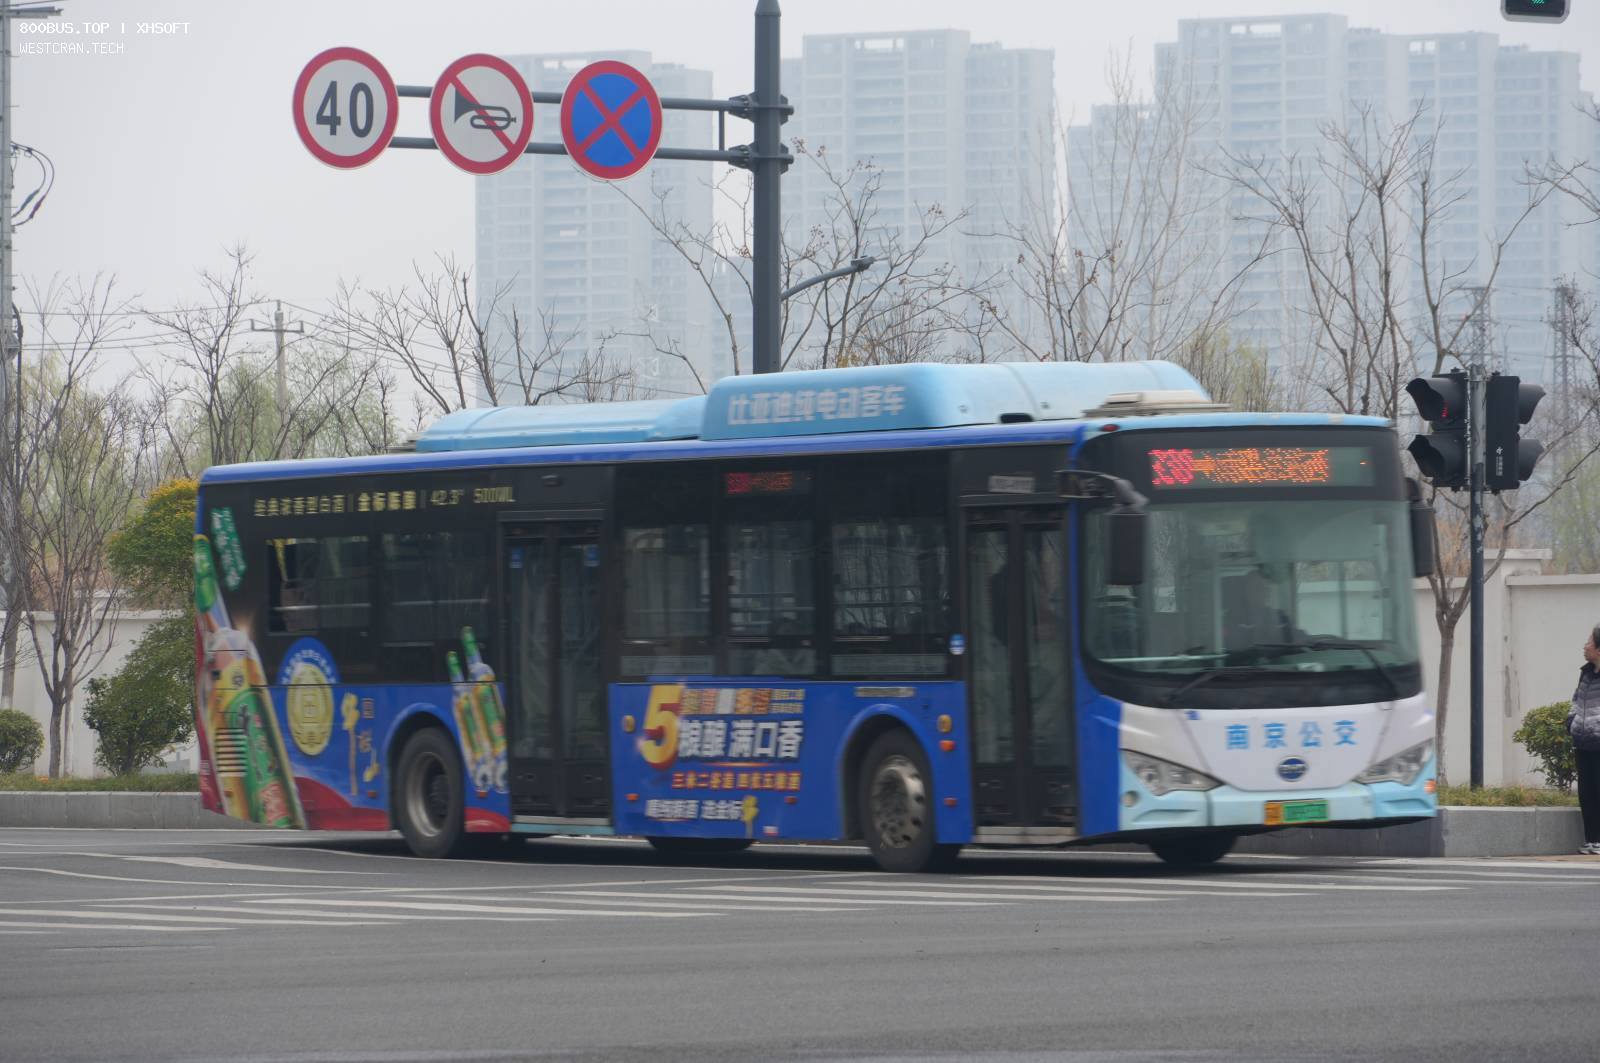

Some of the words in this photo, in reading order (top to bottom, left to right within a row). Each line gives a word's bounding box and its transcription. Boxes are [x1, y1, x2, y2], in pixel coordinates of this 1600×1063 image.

[316, 80, 374, 138] 40
[1225, 720, 1358, 750] 南京公交
